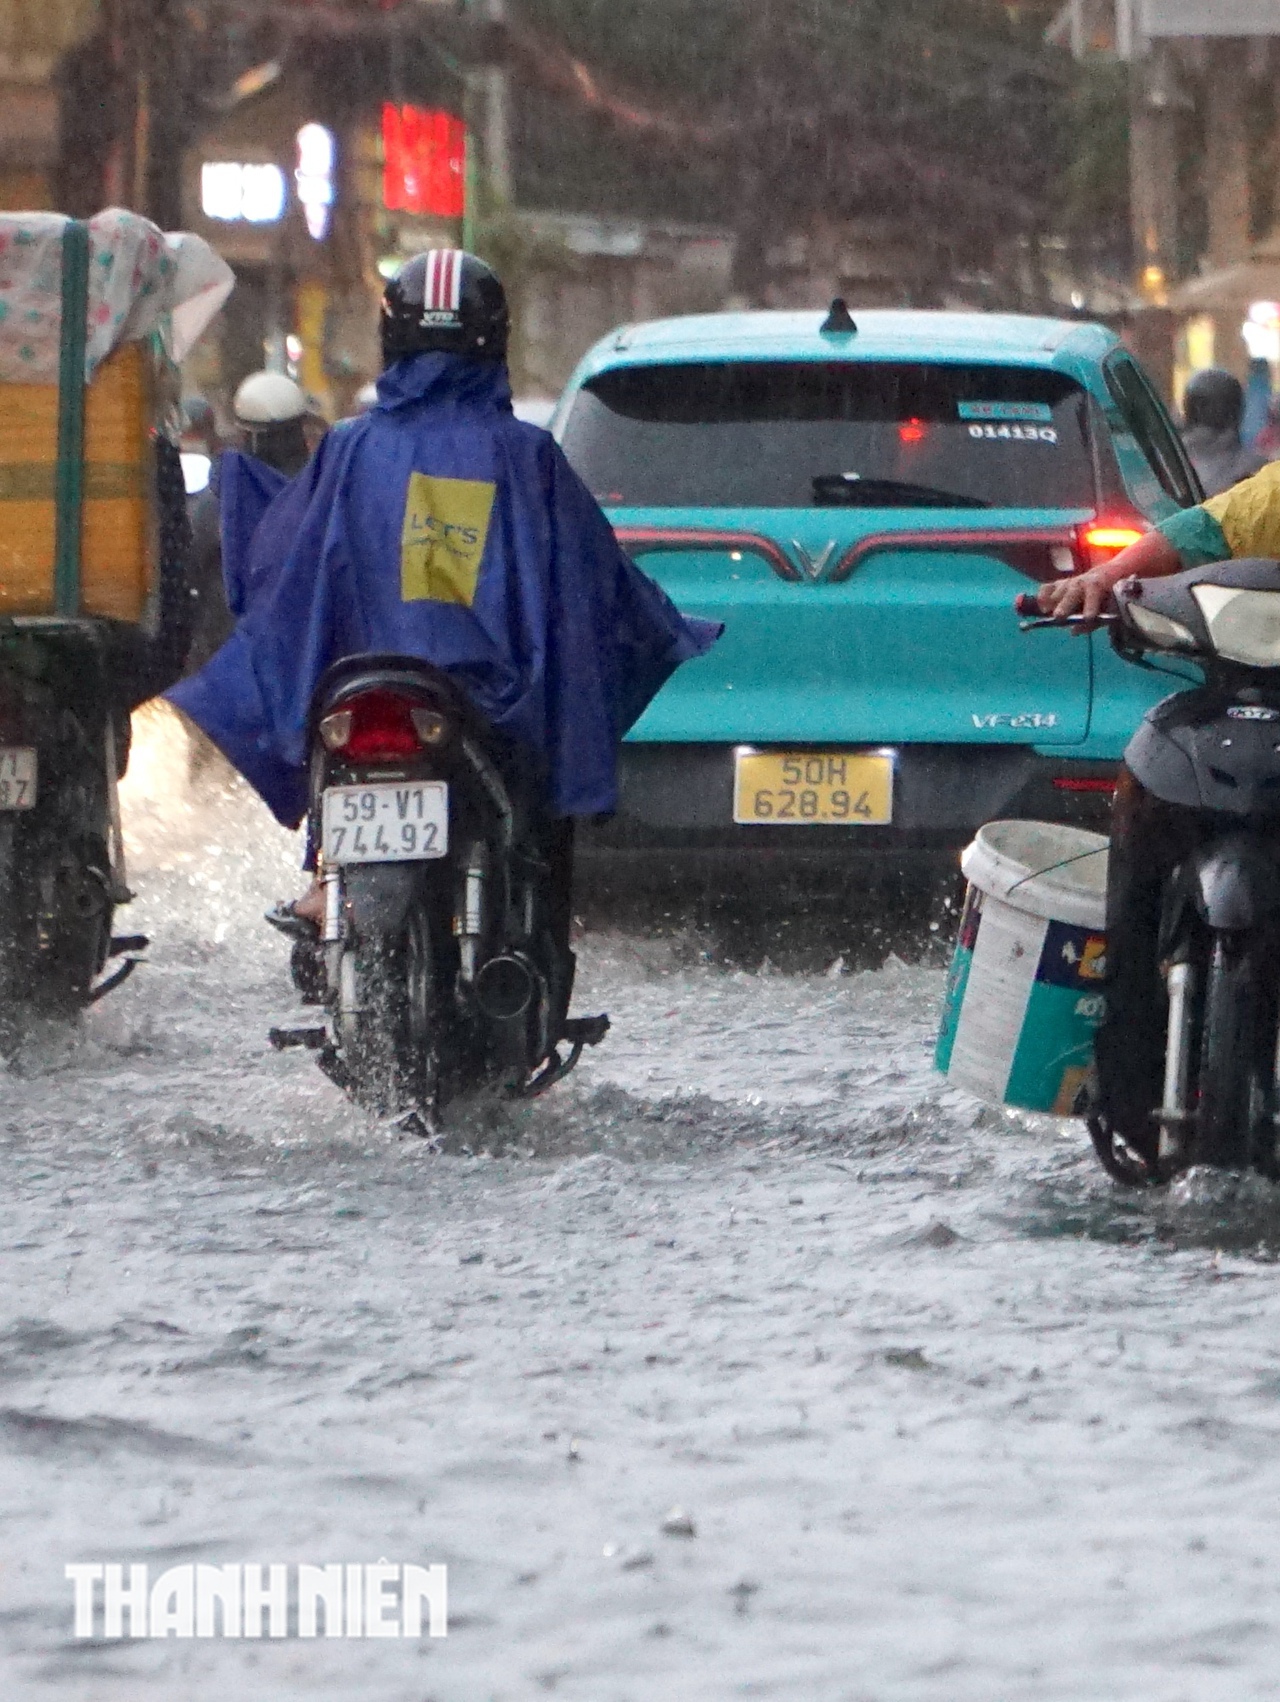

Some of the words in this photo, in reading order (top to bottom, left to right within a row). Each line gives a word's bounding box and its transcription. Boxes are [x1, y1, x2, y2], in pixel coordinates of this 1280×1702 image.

[968, 424, 1058, 443] 01413Q
[782, 757, 847, 786] 50H
[342, 790, 424, 822] 59-V1
[753, 790, 872, 818] 628.94
[331, 823, 438, 857] 744.92
